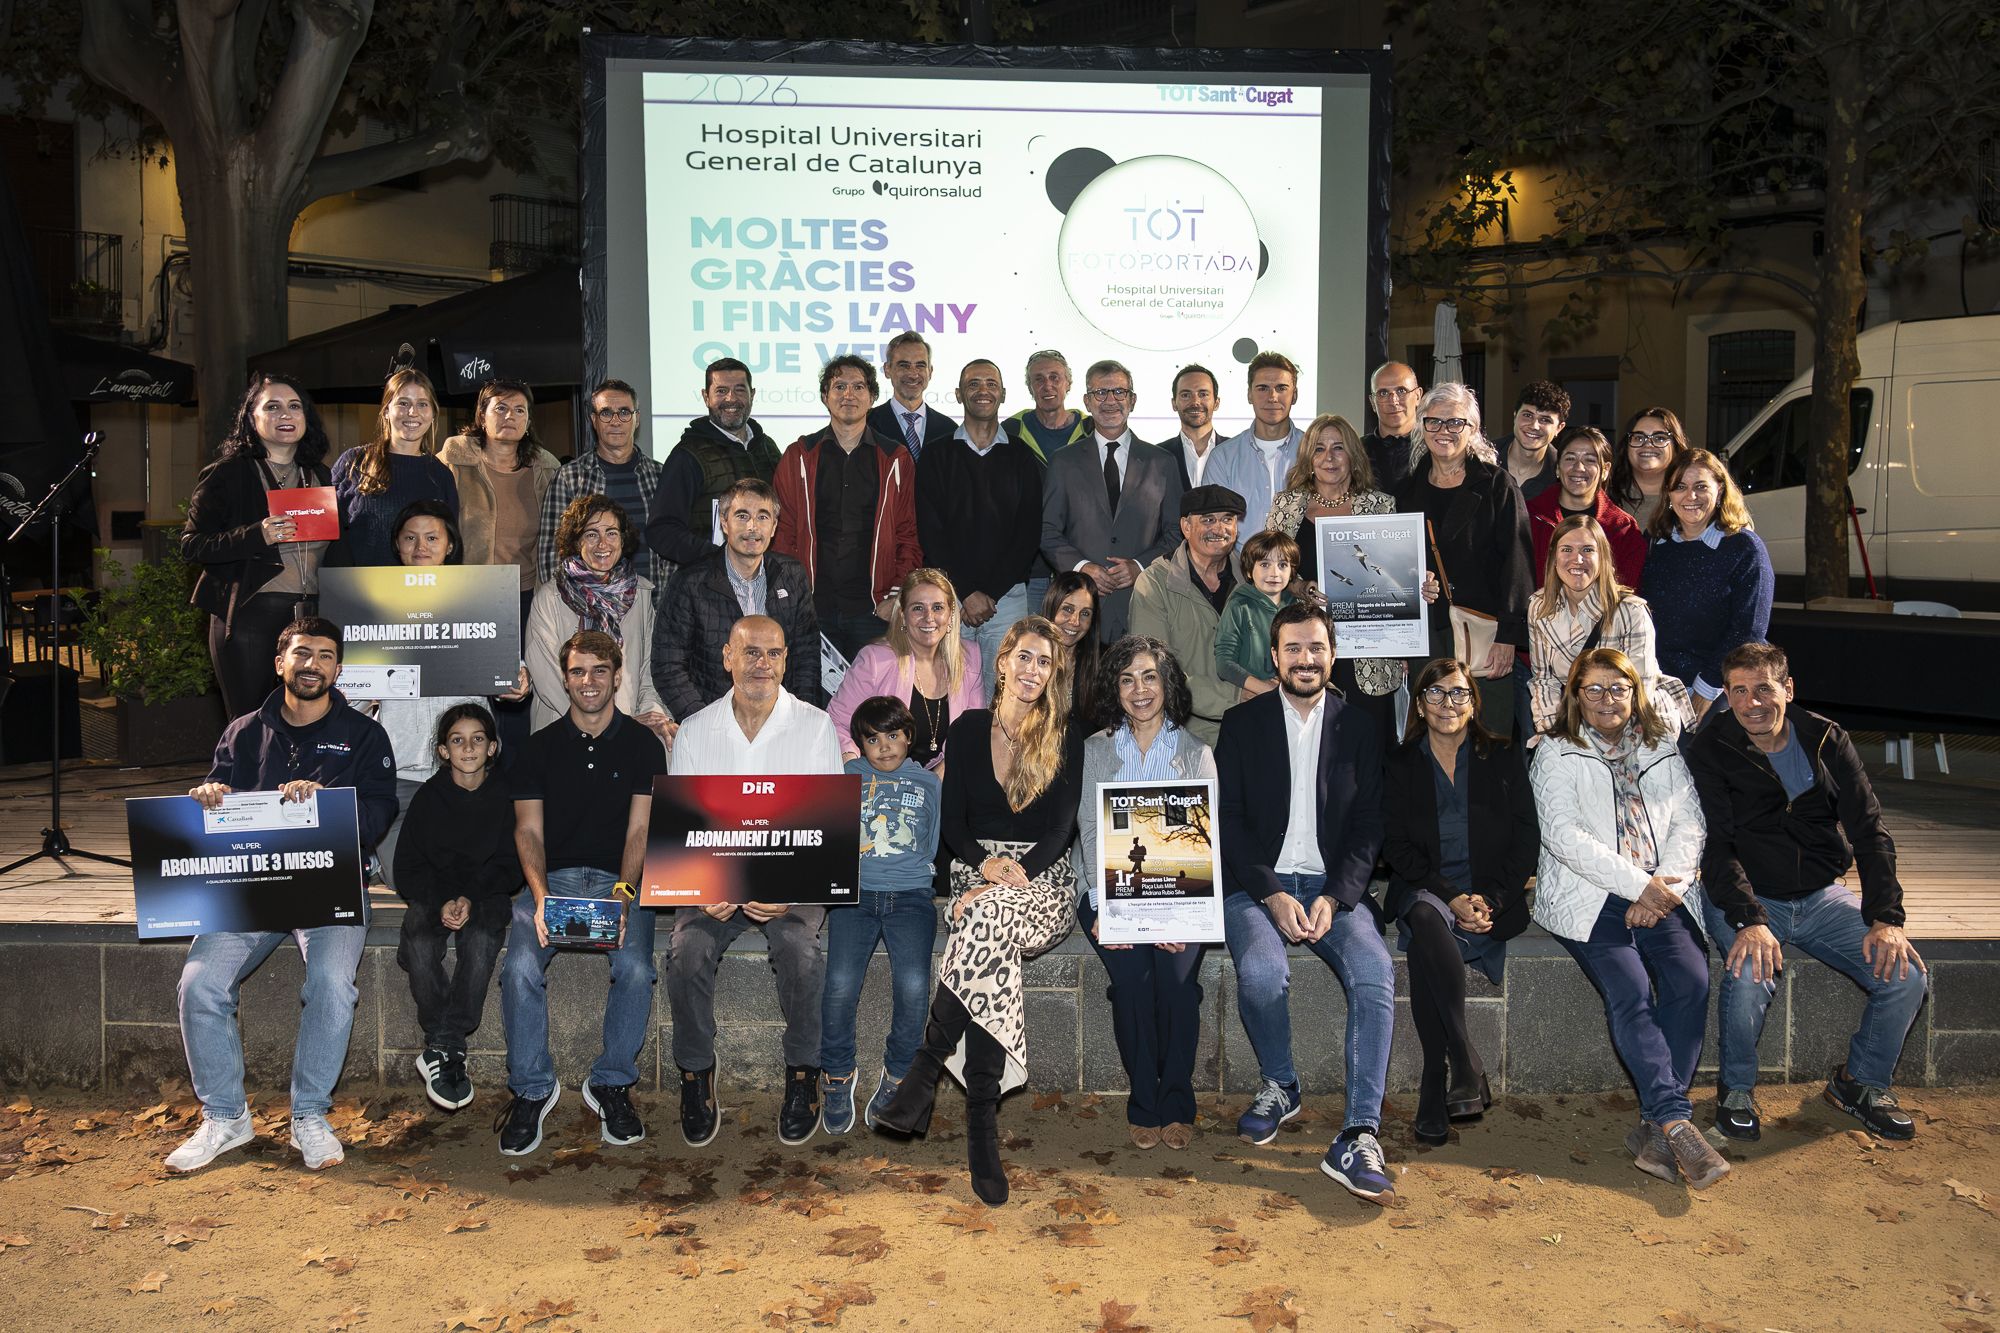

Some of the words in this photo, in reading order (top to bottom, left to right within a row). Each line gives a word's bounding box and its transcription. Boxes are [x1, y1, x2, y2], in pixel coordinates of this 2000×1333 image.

[685, 74, 798, 107] 2026
[1246, 87, 1293, 107] Cugat
[701, 124, 821, 148] Hospital
[831, 126, 982, 148] Universitari
[686, 151, 796, 172] General
[806, 153, 839, 172] de
[849, 154, 982, 178] Catalunya
[832, 186, 865, 197] Grupo
[690, 216, 889, 250] MOLTES
[690, 251, 915, 292] GRÀCIES
[1107, 285, 1156, 296] Hospital
[1159, 285, 1224, 295] Universitari
[1100, 297, 1146, 307] General
[1149, 298, 1164, 307] de
[1167, 298, 1224, 310] Catalunya
[692, 300, 704, 331] I
[722, 301, 834, 332] FINS
[849, 302, 978, 334] L'ANY
[693, 341, 801, 373] QUE
[460, 356, 491, 379] 18/70
[1328, 530, 1352, 541] TOT
[1353, 529, 1376, 540] Sant
[1381, 529, 1411, 540] Cugat
[1332, 601, 1355, 609] PREMI
[343, 623, 421, 641] ABONAMENT
[424, 623, 439, 640] DE
[441, 622, 450, 640] 2
[452, 622, 497, 639] MESOS
[742, 781, 775, 794] DiR
[1110, 796, 1136, 807] TOT
[1137, 795, 1163, 806] Sant
[1168, 794, 1202, 808] Cugat
[685, 830, 769, 847] ABONAMENT
[770, 829, 790, 847] D'1
[792, 829, 823, 846] MES
[161, 855, 249, 877] ABONAMENT
[252, 853, 269, 872] DE
[271, 853, 282, 871] 3
[283, 850, 334, 870] MESOS
